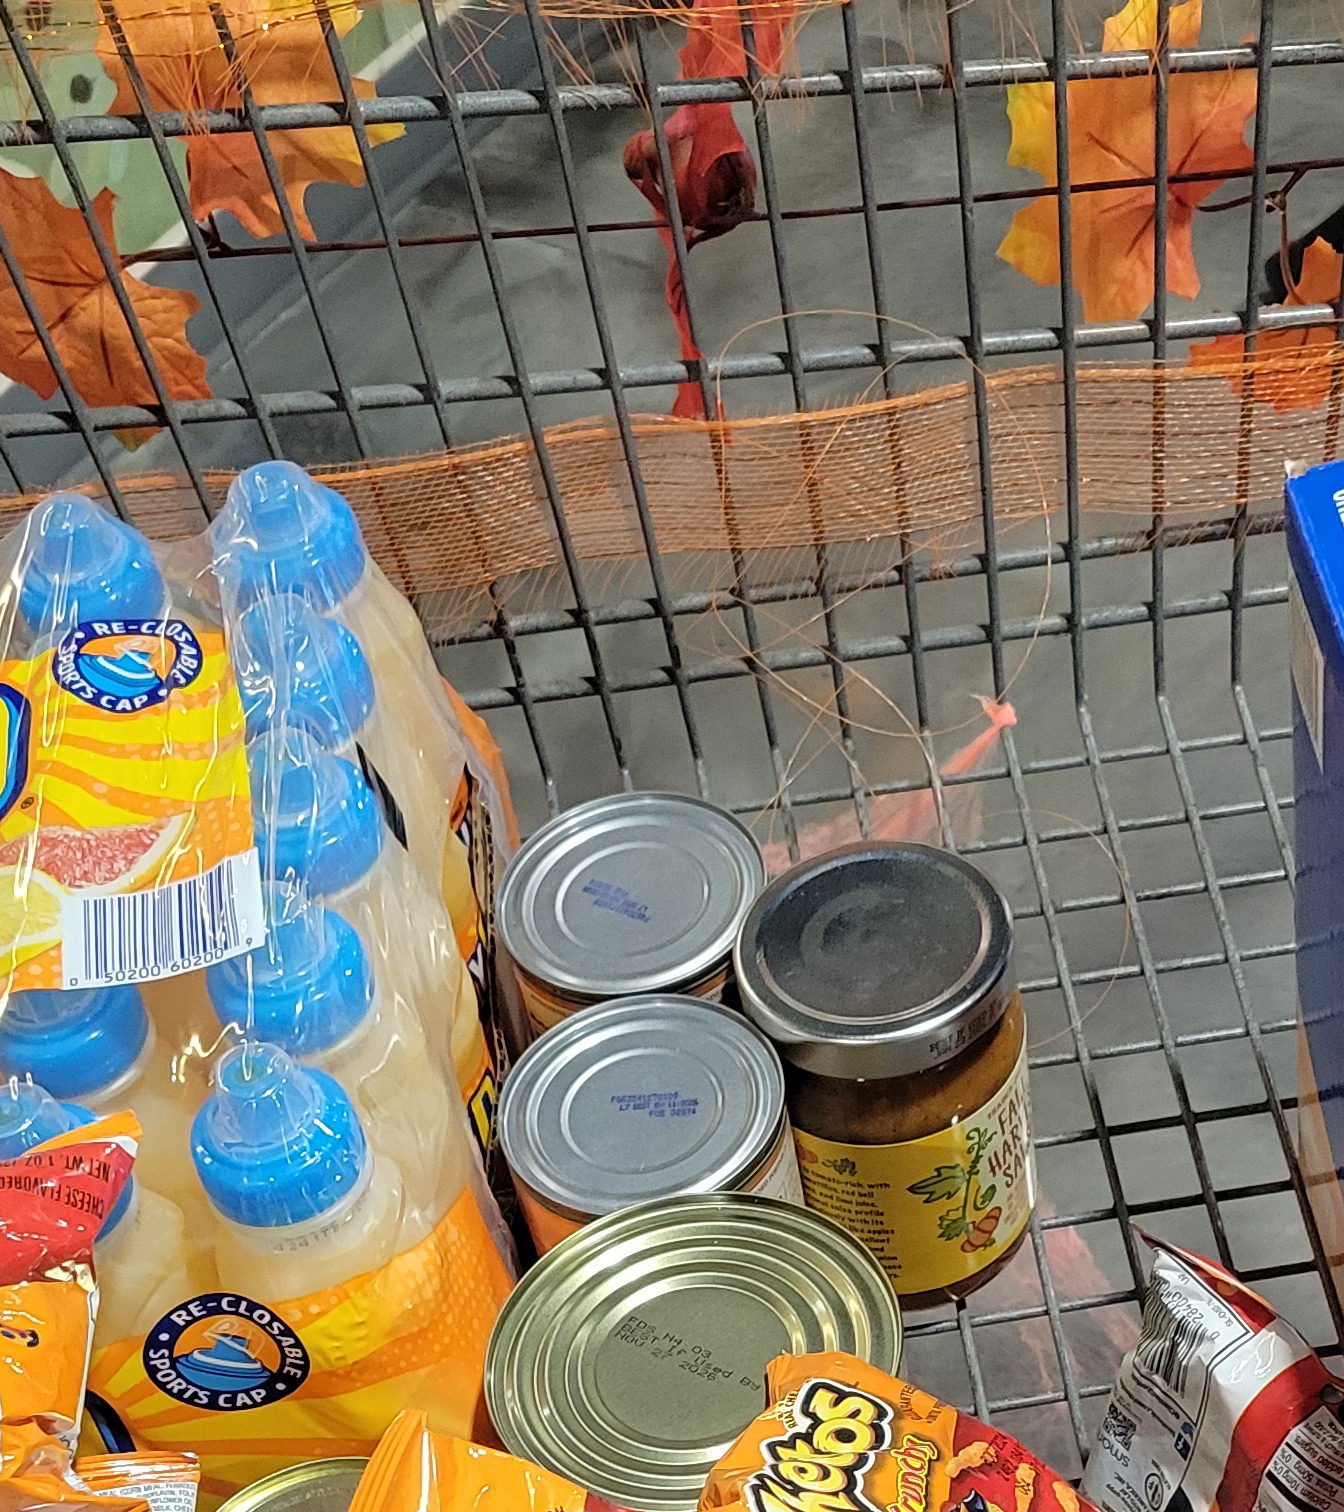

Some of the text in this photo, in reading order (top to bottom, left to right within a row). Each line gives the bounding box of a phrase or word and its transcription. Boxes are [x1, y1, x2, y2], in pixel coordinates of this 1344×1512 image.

[59, 644, 148, 712] SPORTS CAP
[93, 620, 200, 688] RE-CLOSABLE
[104, 949, 224, 983] 50200 60200
[169, 1296, 305, 1379] RE-CLOSABLE
[614, 1329, 645, 1348] NOV
[678, 1360, 718, 1382] 2026
[620, 1323, 661, 1344] BEST
[693, 1356, 734, 1379] Used
[149, 1347, 267, 1408] SPORTS CAP
